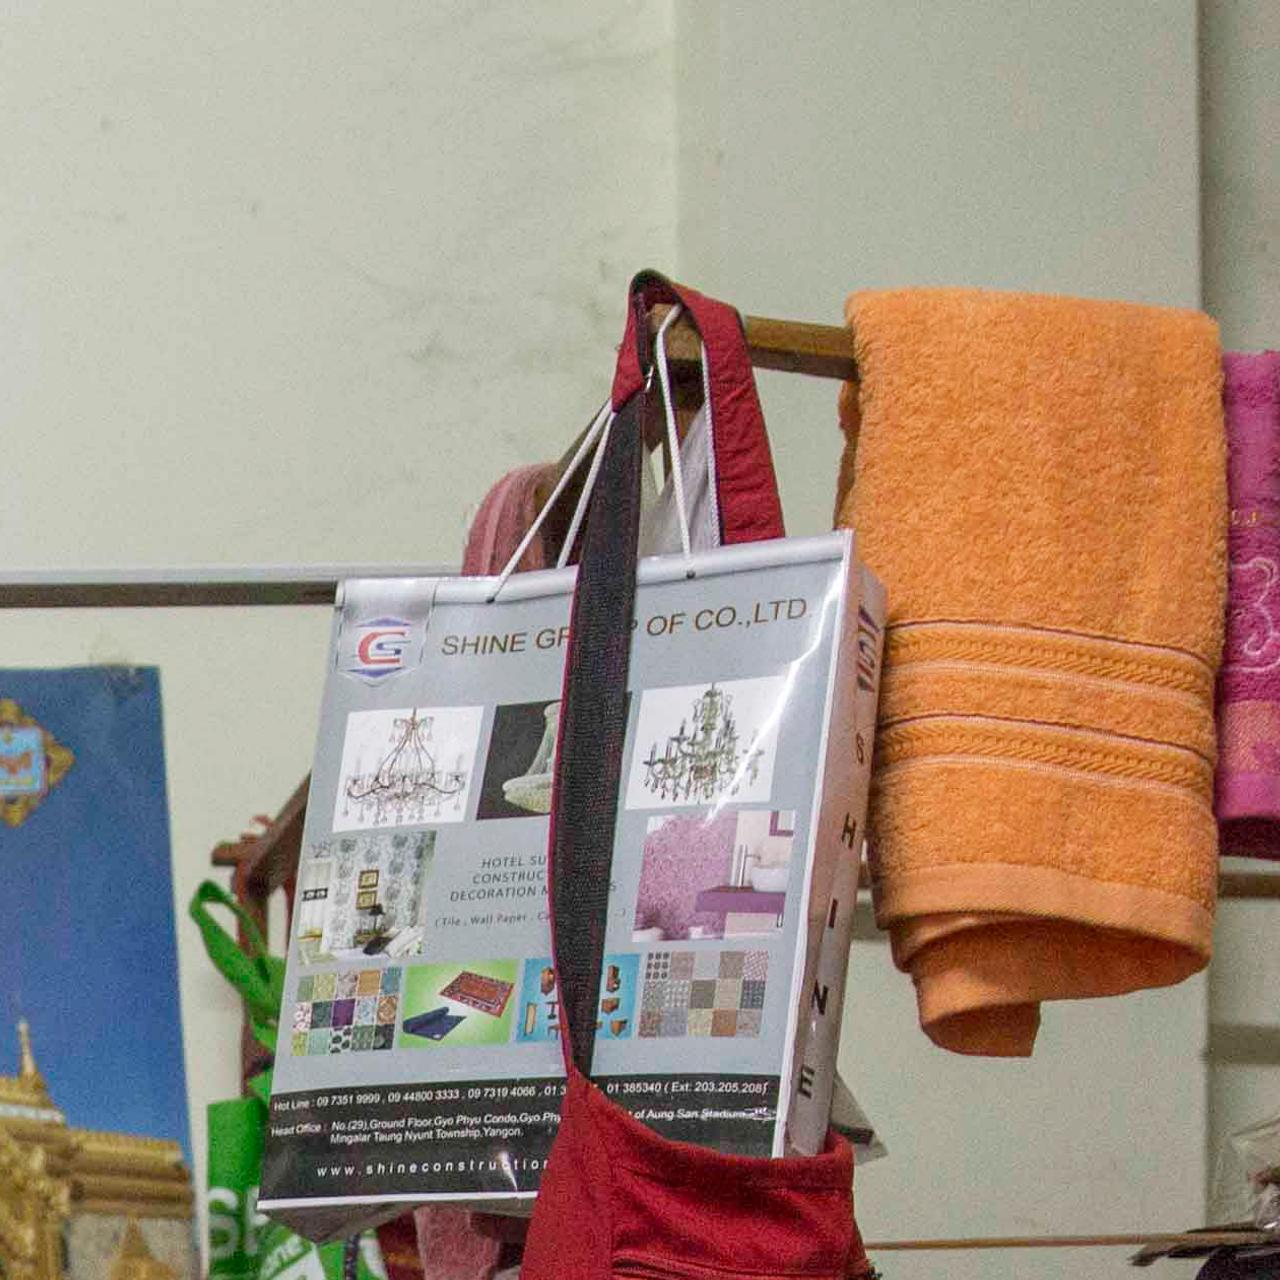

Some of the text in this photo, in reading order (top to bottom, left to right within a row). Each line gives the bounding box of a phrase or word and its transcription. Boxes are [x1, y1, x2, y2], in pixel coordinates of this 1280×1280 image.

[440, 633, 527, 656] SHINE
[646, 610, 684, 637] OF
[481, 856, 523, 869] HOTEL
[471, 870, 546, 885] CONSTRUC
[449, 887, 537, 902] DECORATION
[470, 914, 493, 925] Wall
[496, 913, 526, 926] Paper
[273, 1101, 290, 1112] Hot
[316, 1097, 329, 1107] 09
[330, 1094, 354, 1106] 7351
[356, 1093, 381, 1104] 9999
[387, 1092, 401, 1102] 09
[402, 1090, 433, 1101] 44800
[434, 1089, 460, 1100] 3333
[467, 1087, 481, 1098] 09
[483, 1087, 508, 1097] 7319
[510, 1085, 536, 1096] 4066
[544, 1085, 556, 1096] 01
[606, 1082, 619, 1094] 01
[622, 1081, 662, 1093] 385340
[646, 1107, 675, 1121] Aung
[676, 1107, 698, 1119] San
[330, 1132, 371, 1145] Mingalar
[404, 1129, 433, 1143] Nyunt
